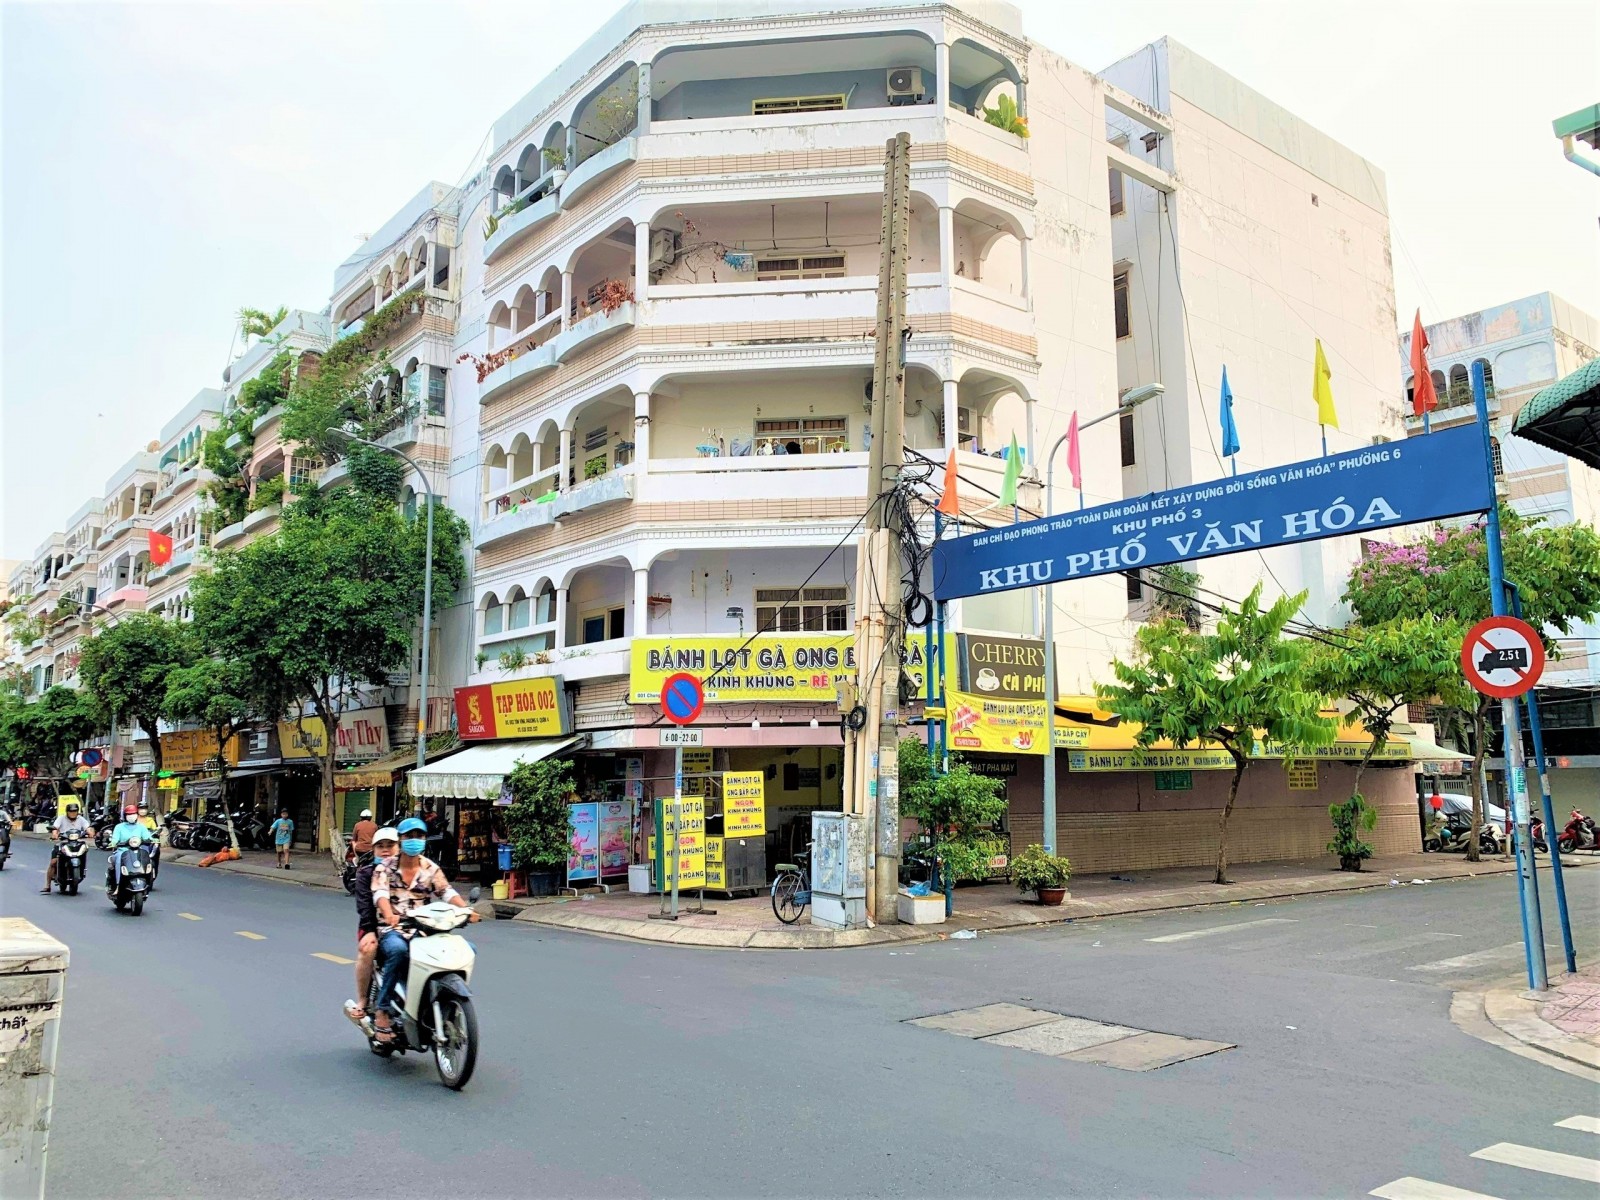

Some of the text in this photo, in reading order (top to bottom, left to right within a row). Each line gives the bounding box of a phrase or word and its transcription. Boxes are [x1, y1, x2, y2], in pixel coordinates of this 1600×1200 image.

[973, 537, 988, 547] BAN
[989, 531, 1003, 545] CHỈ
[1004, 530, 1020, 542] ĐẠO
[1021, 524, 1049, 538] PHONG
[1050, 518, 1073, 531] TRÀO
[1103, 507, 1121, 520] DÂN
[1123, 501, 1149, 516] ĐOÀN
[1151, 494, 1170, 511] KẾT
[1173, 491, 1193, 506] XÂY
[1195, 486, 1224, 502] DỰNG
[1226, 480, 1245, 495] ĐỜI
[1247, 472, 1278, 490] SỐNG
[1279, 469, 1304, 483] VĂN
[1338, 451, 1390, 471] PHƯỜNG
[1392, 448, 1401, 460] 6
[1112, 507, 1203, 536] KHU PHỐ 3
[979, 495, 1402, 590] KHU PHỐ VĂN HÓA
[648, 645, 706, 671] BÁNH
[710, 648, 751, 674] LỌT
[757, 644, 788, 670] GÀ
[794, 646, 839, 669] ONG
[971, 641, 1046, 667] CHERRY
[707, 676, 742, 689] KINH
[746, 672, 796, 689] KHỦNG
[811, 671, 830, 688] RẺ
[1002, 671, 1020, 692] CÀ
[496, 688, 556, 718] TẠP HÓA 002
[337, 721, 354, 753] hy
[353, 719, 384, 753] Thy
[1063, 729, 1075, 738] BẮP
[986, 763, 1000, 772] PHA
[1000, 761, 1015, 772] MÁY
[1090, 754, 1111, 768] BÁNH
[1160, 754, 1174, 767] BẮP
[1175, 754, 1190, 767] CÀY
[726, 776, 741, 785] BÁNH
[682, 803, 693, 815] LỌT
[695, 802, 703, 812] GÀ
[691, 817, 703, 828] CÀY
[683, 846, 704, 855] KHỦNG
[681, 858, 690, 870] RẺ
[683, 869, 704, 879] HOÀNG
